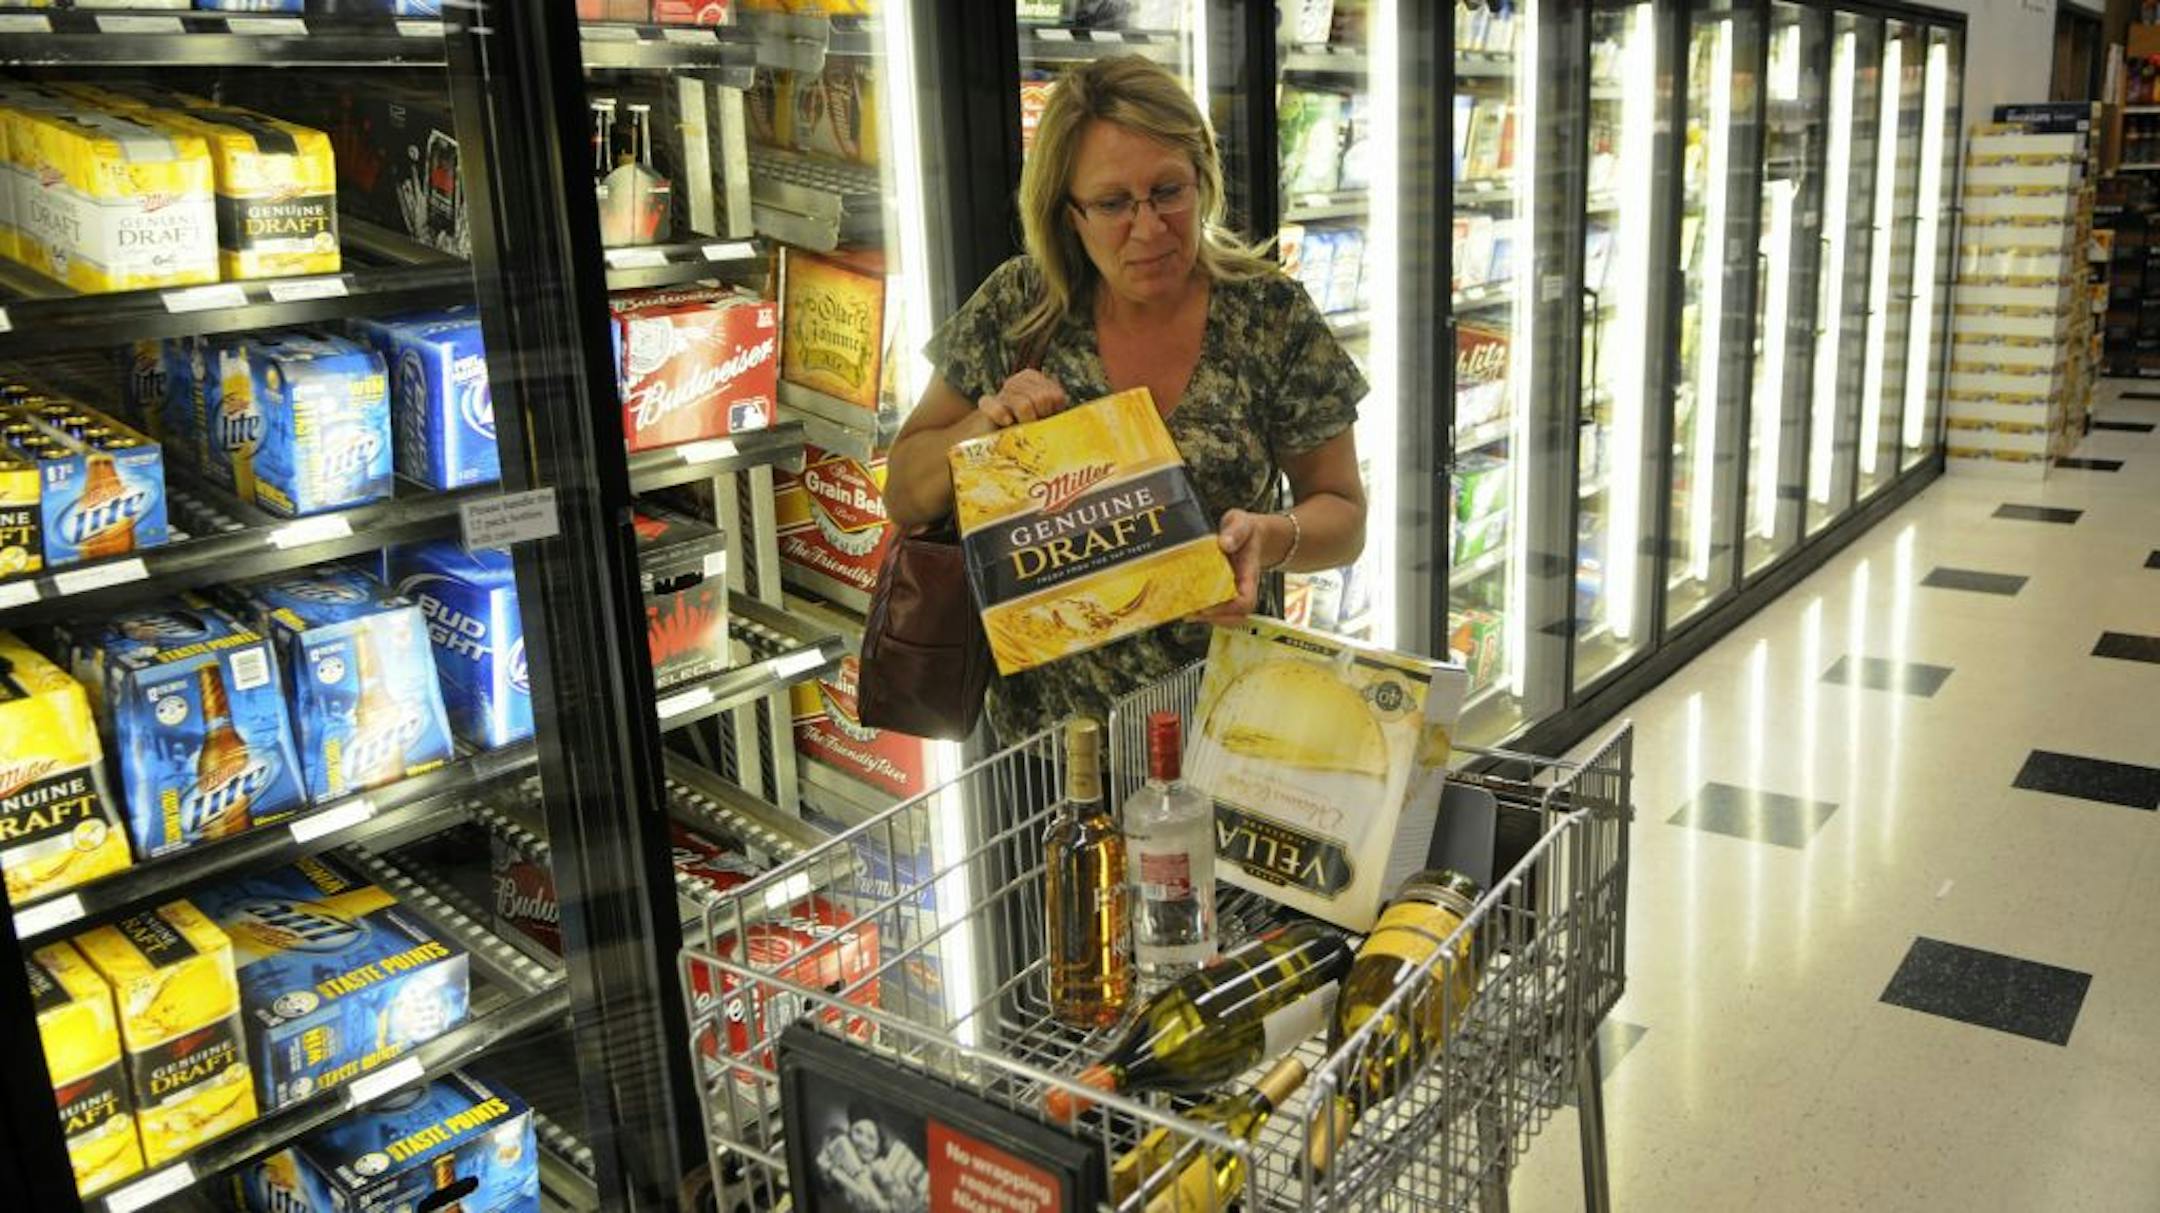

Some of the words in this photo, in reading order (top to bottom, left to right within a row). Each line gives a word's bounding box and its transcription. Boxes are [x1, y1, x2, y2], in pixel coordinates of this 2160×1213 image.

[245, 216, 329, 236] DRAFT
[247, 204, 325, 219] GENUINE
[627, 338, 775, 428] Budweiser
[965, 444, 983, 459] 12
[805, 470, 851, 504] Grain
[1028, 462, 1117, 514] Miller
[1010, 487, 1155, 547] GENUINE
[1008, 505, 1167, 580] DRAFT
[418, 593, 487, 640] BUD
[428, 621, 493, 662] GHT
[656, 659, 720, 688] ELECT
[2, 777, 86, 814] NUINE
[0, 793, 98, 842] RAFT
[1215, 819, 1326, 886] VELLA
[379, 940, 450, 976] POINTS
[150, 1039, 233, 1080] GENUINE
[150, 1045, 238, 1096] DRAFT
[65, 1096, 119, 1133] AFT
[443, 1095, 510, 1136] POINTS
[945, 1140, 971, 1166] No
[970, 1155, 1053, 1207] wrapping
